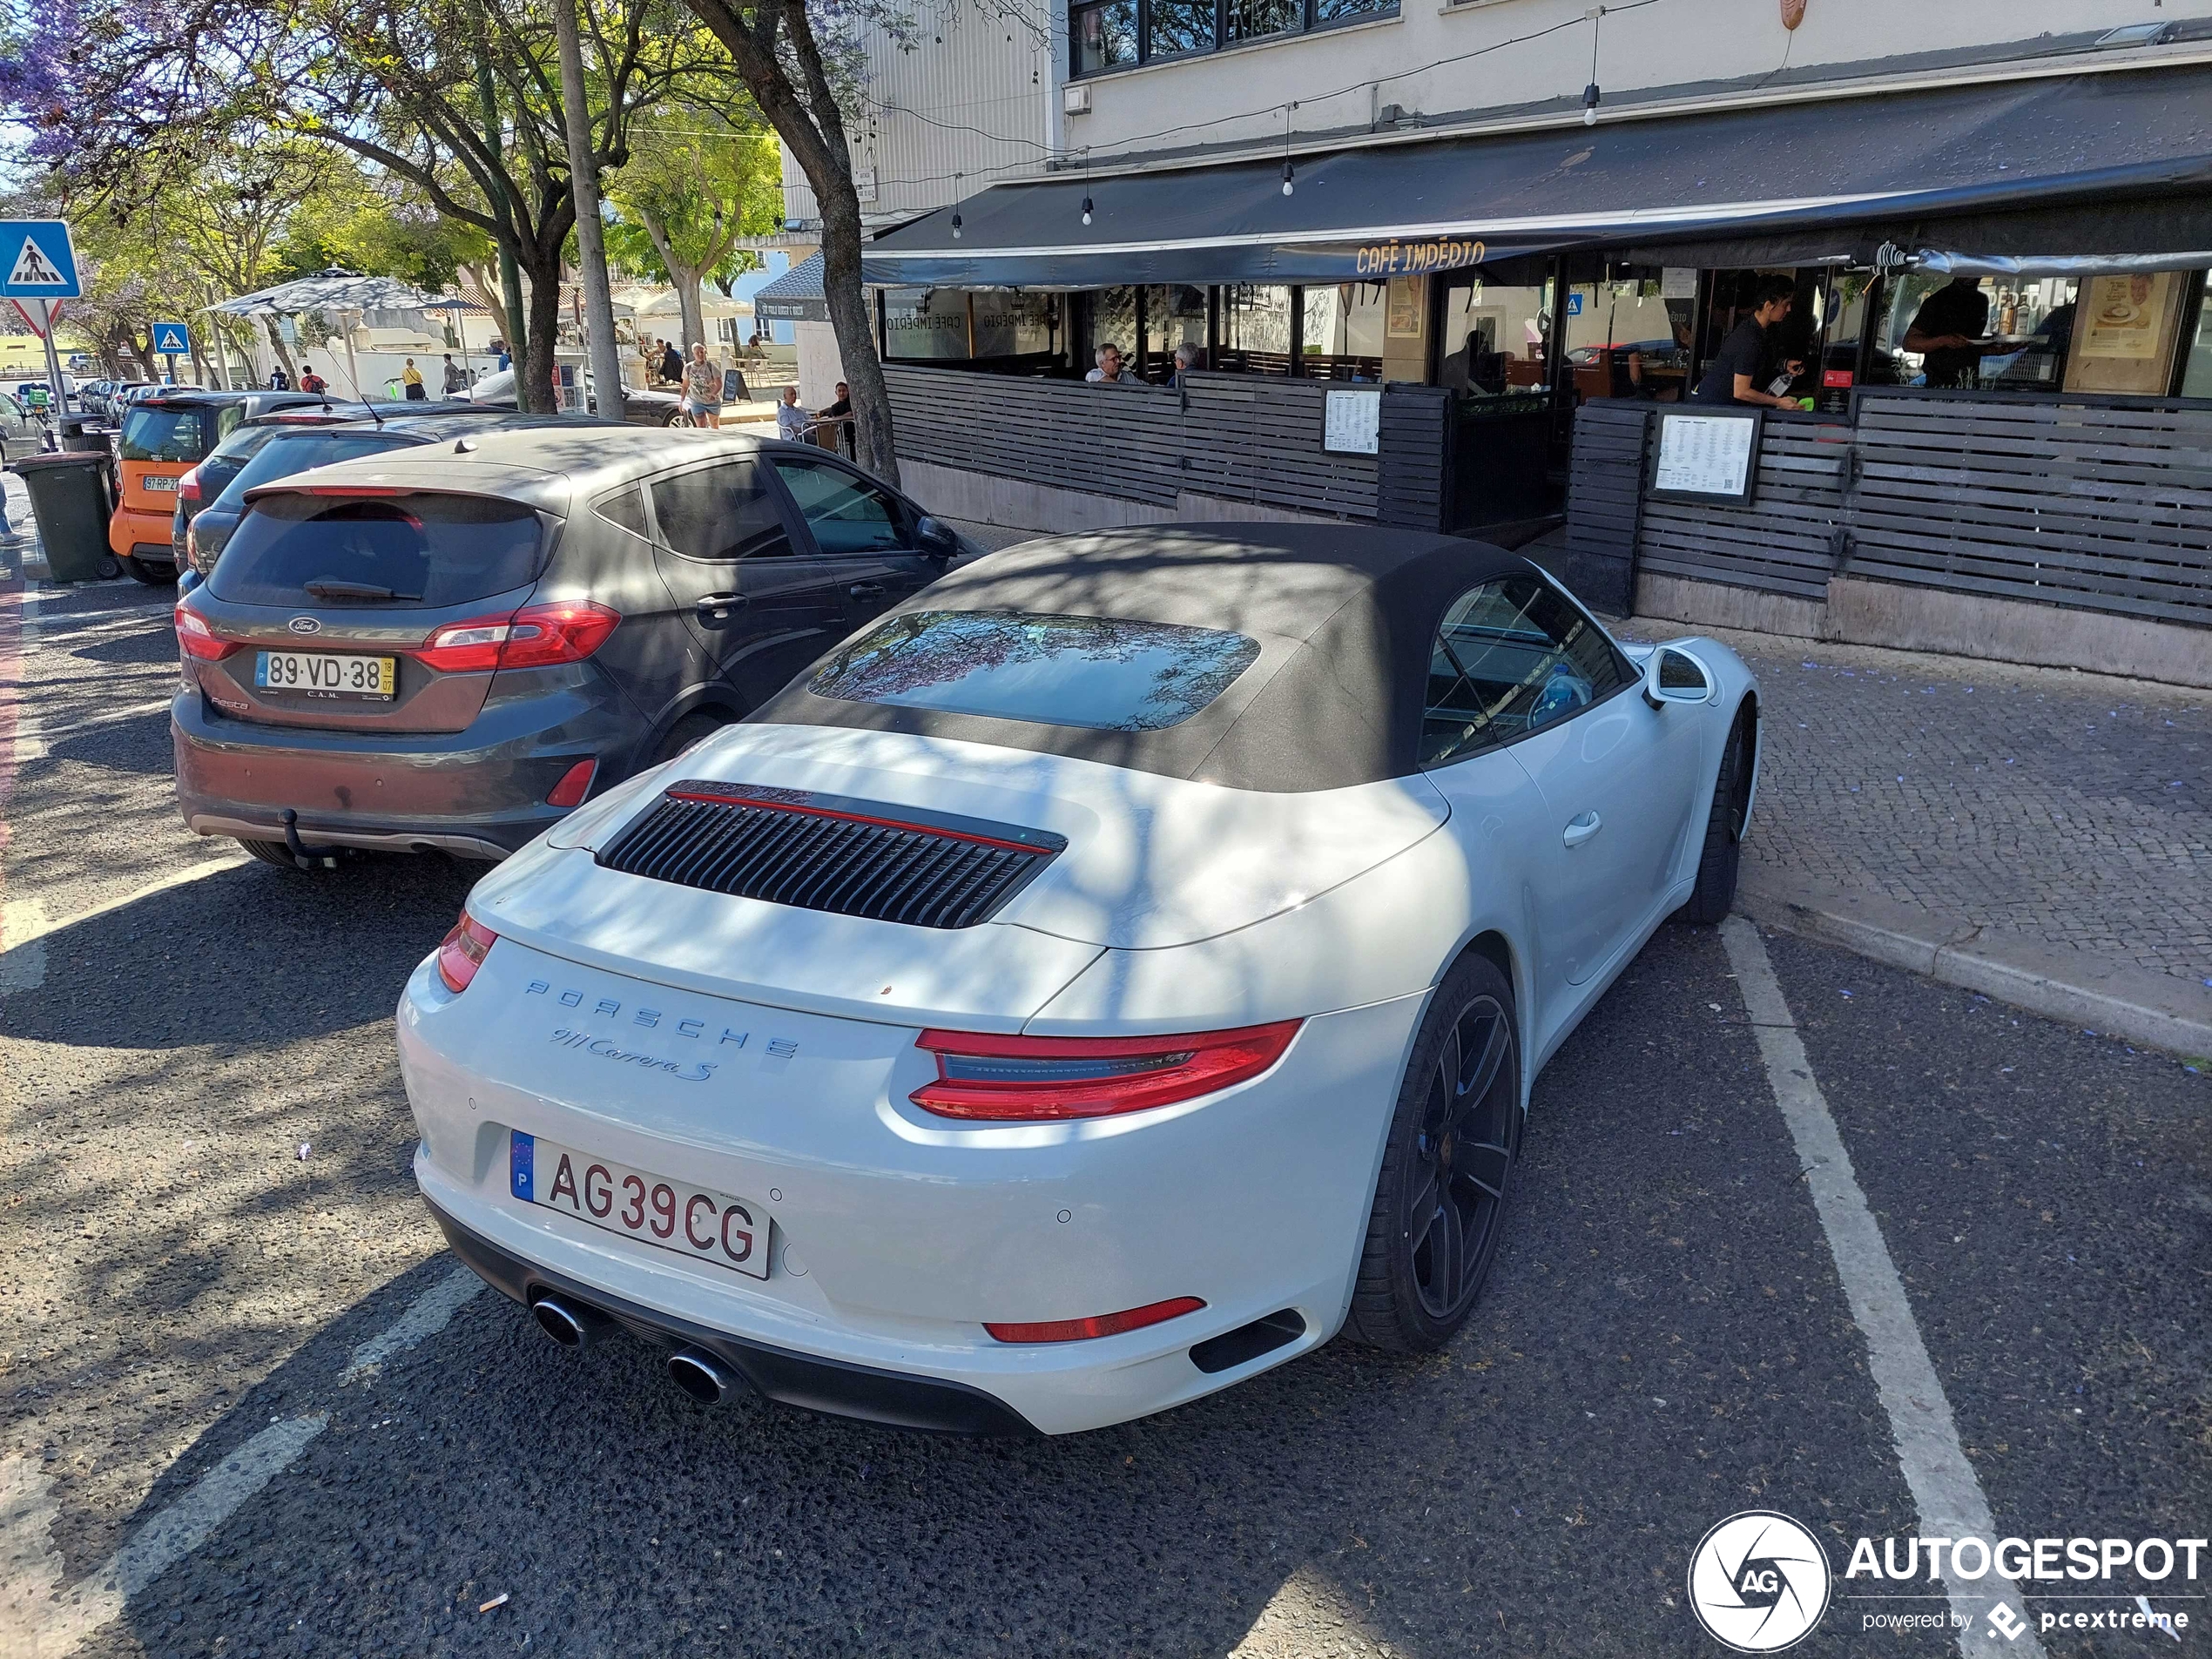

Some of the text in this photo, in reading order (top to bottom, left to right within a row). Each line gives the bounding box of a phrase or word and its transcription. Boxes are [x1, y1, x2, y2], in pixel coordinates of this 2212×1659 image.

[1402, 235, 1485, 272] IMPÉRIO
[294, 620, 314, 631] Ford
[384, 662, 392, 672] 18
[382, 680, 392, 691] 07
[212, 698, 249, 711] Fiesta
[524, 979, 799, 1059] PORSCHE
[549, 1027, 718, 1082] 911 Carrera S
[517, 1172, 528, 1187] P
[550, 1152, 753, 1263] AG39CG
